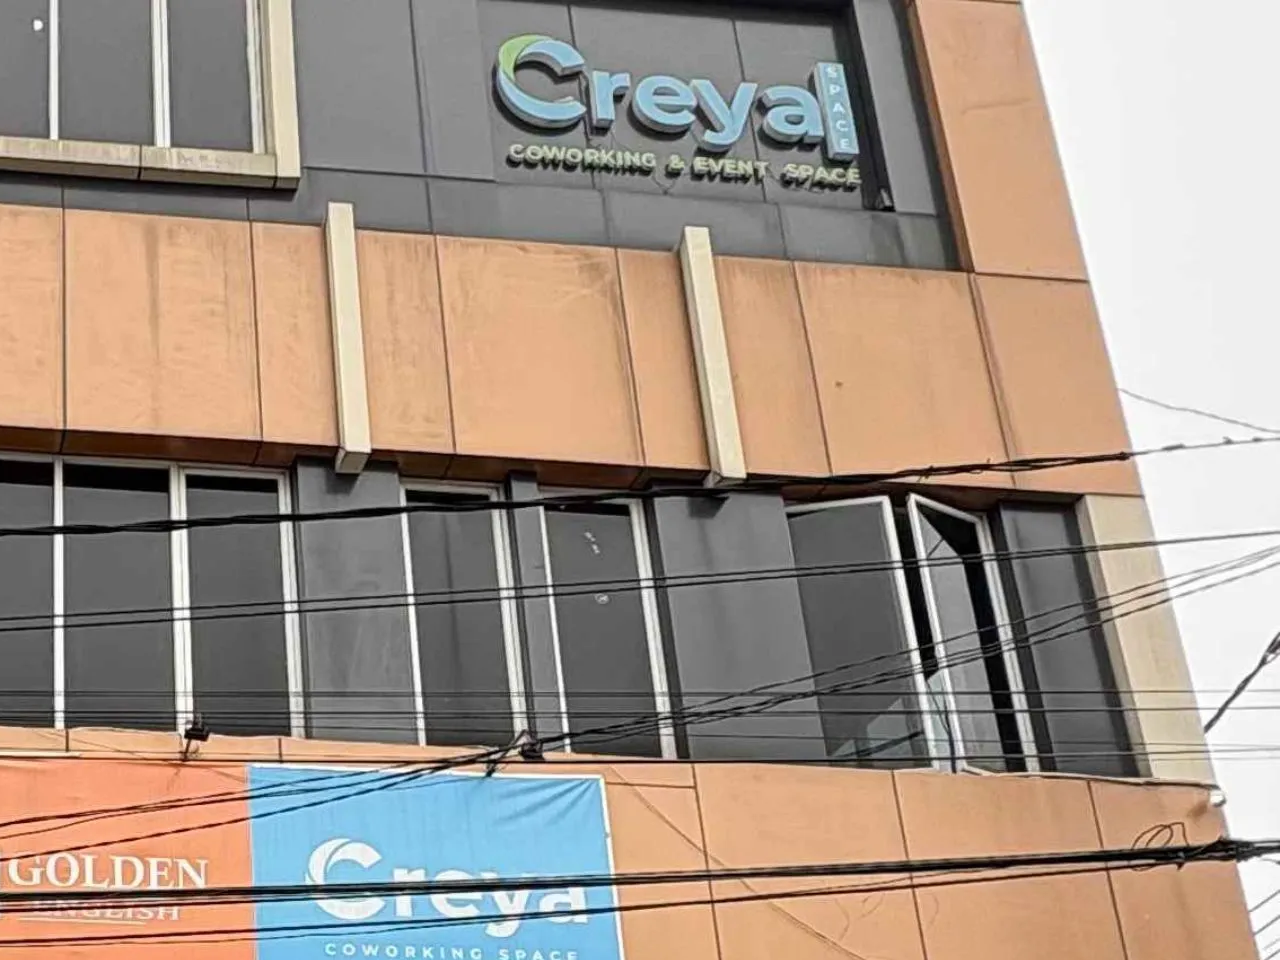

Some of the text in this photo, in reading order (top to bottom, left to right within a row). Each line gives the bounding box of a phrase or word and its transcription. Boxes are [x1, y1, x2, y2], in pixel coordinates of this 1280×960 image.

[508, 142, 862, 185] COWORKING & EVENT SPACE
[8, 852, 209, 890] GOLDEN
[305, 838, 589, 938] Creya
[324, 942, 483, 960] COWORKING
